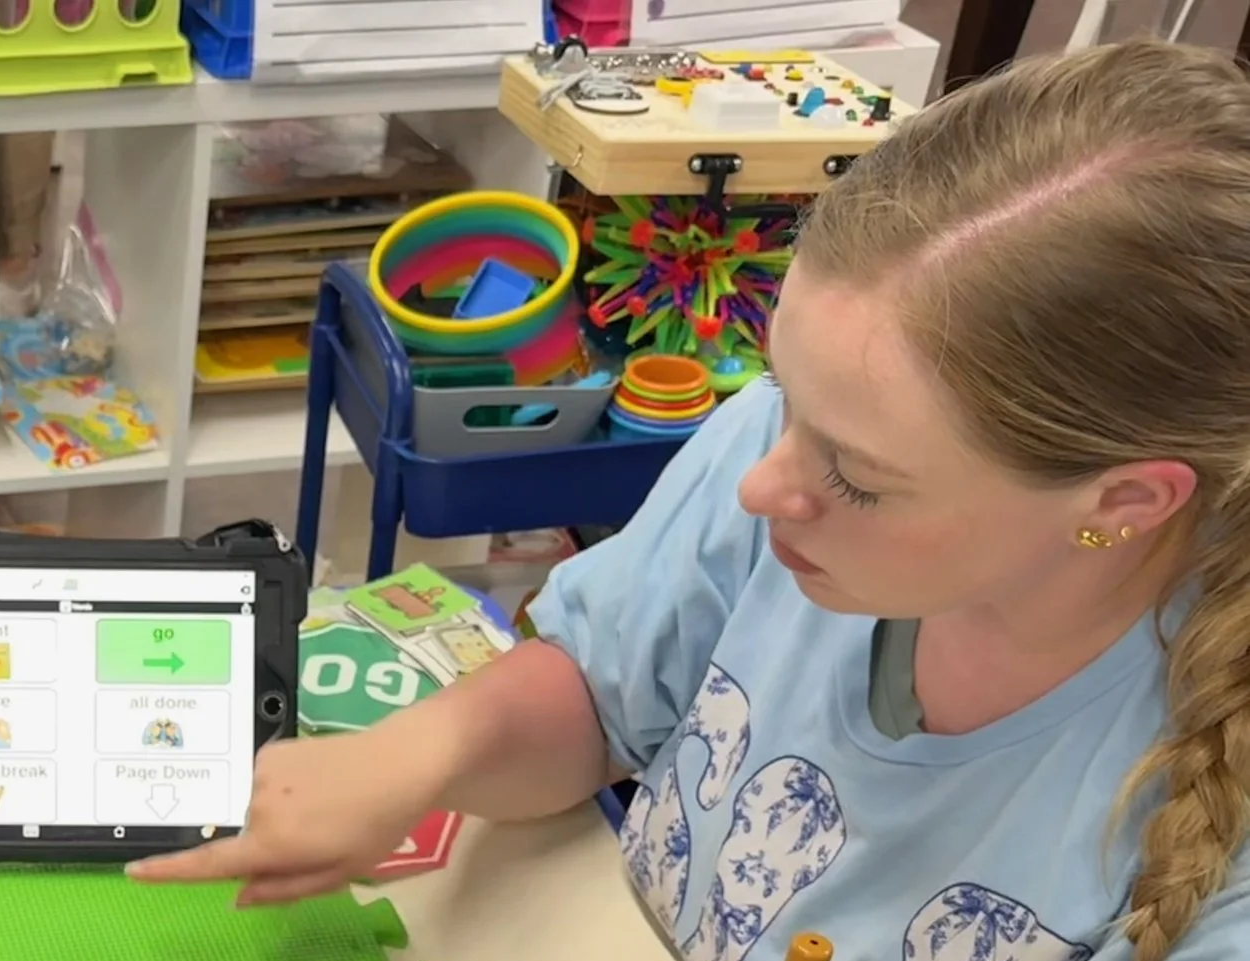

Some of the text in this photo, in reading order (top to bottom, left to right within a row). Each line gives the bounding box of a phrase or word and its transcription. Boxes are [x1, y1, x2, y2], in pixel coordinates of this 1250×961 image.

[153, 628, 174, 643] go
[301, 653, 420, 706] GO
[129, 696, 197, 709] all done
[1, 764, 48, 778] break
[115, 765, 210, 781] Page Down
